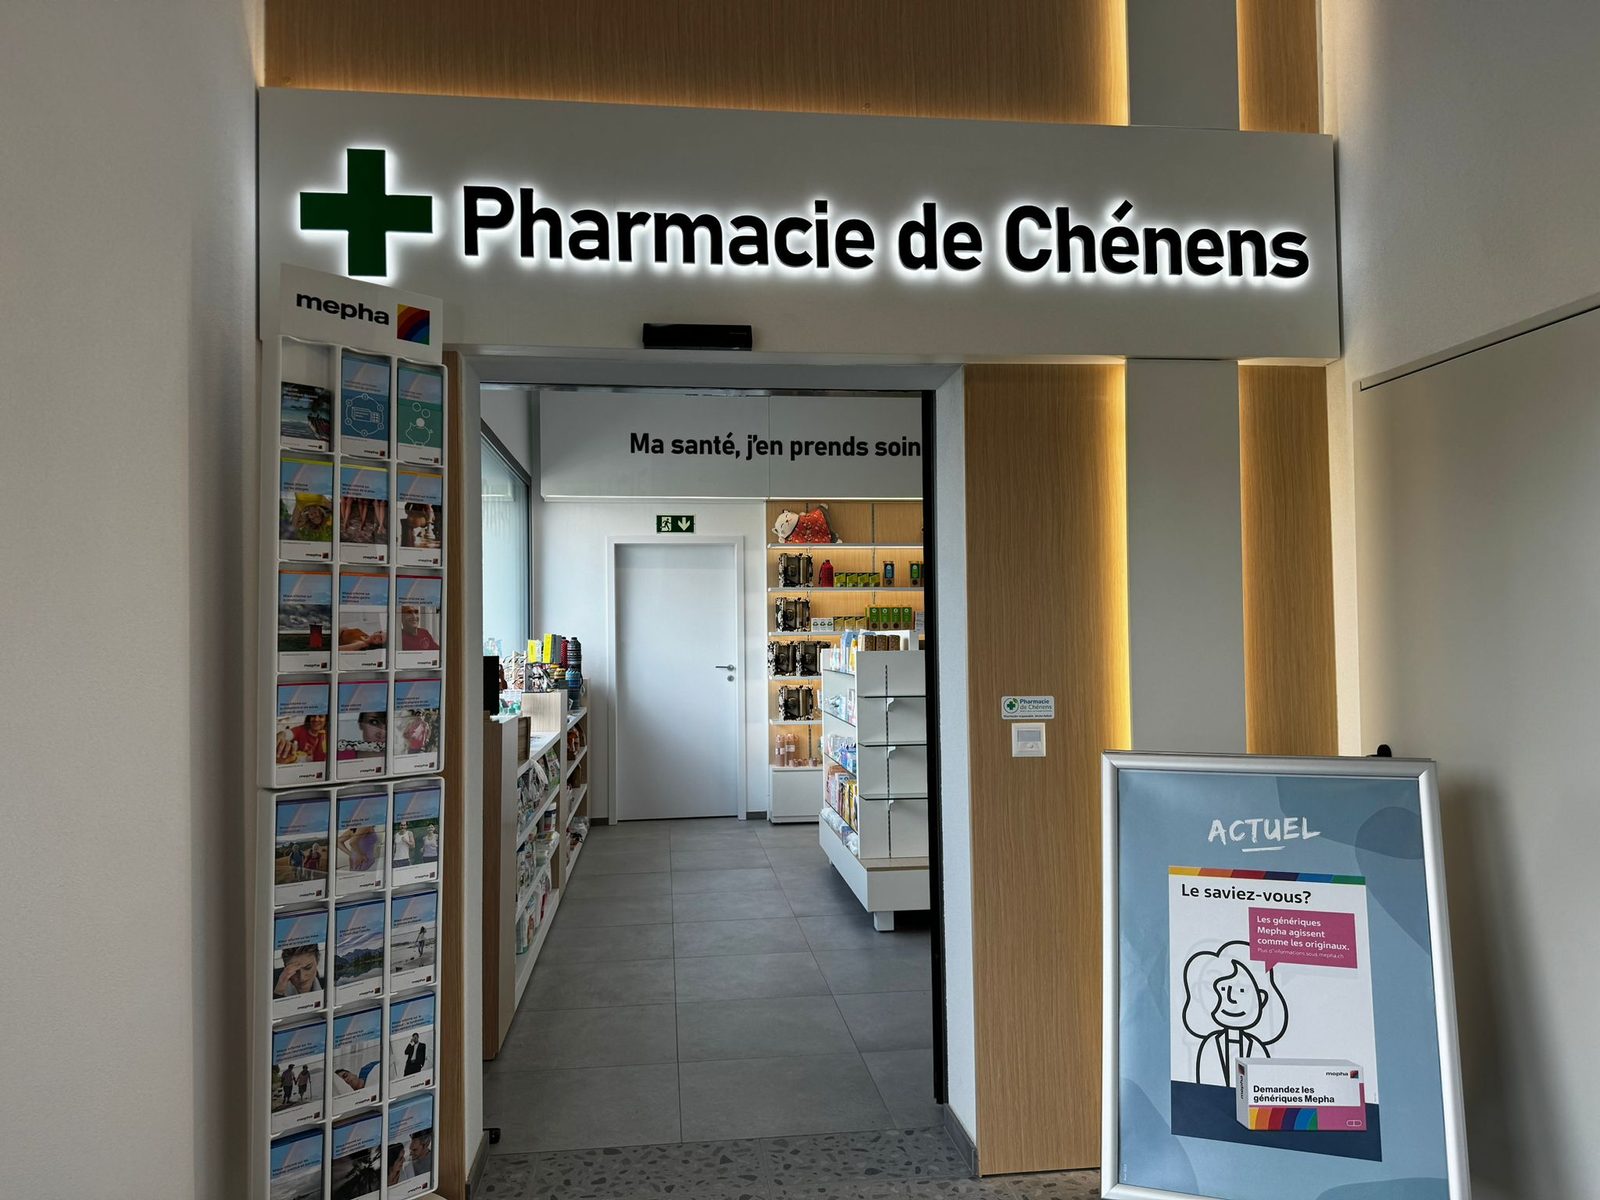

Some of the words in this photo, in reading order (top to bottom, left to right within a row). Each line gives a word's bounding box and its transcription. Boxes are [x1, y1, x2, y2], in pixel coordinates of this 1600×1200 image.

[463, 184, 875, 270] Pharmacie
[898, 202, 983, 271] de
[1006, 198, 1309, 278] Chénens
[296, 293, 390, 326] mepha
[630, 432, 665, 455] Ma
[671, 431, 741, 460] santé,
[745, 433, 784, 461] j'en
[790, 435, 869, 461] prends
[874, 436, 921, 458] soin
[1207, 816, 1321, 845] ACTUEL
[1181, 883, 1199, 898] Le
[1204, 886, 1312, 904] saviez-vous?
[1257, 915, 1271, 923] Les
[1273, 917, 1321, 927] génériques
[1257, 927, 1287, 936] Mepha
[1289, 930, 1325, 938] agissent
[1257, 938, 1288, 946] comme
[1291, 939, 1303, 947] les
[1305, 941, 1350, 951] originaux.
[1253, 1085, 1300, 1094] Demandez
[1301, 1086, 1315, 1094] les
[1253, 1095, 1303, 1104] génériques
[1304, 1095, 1335, 1104] Mepha
